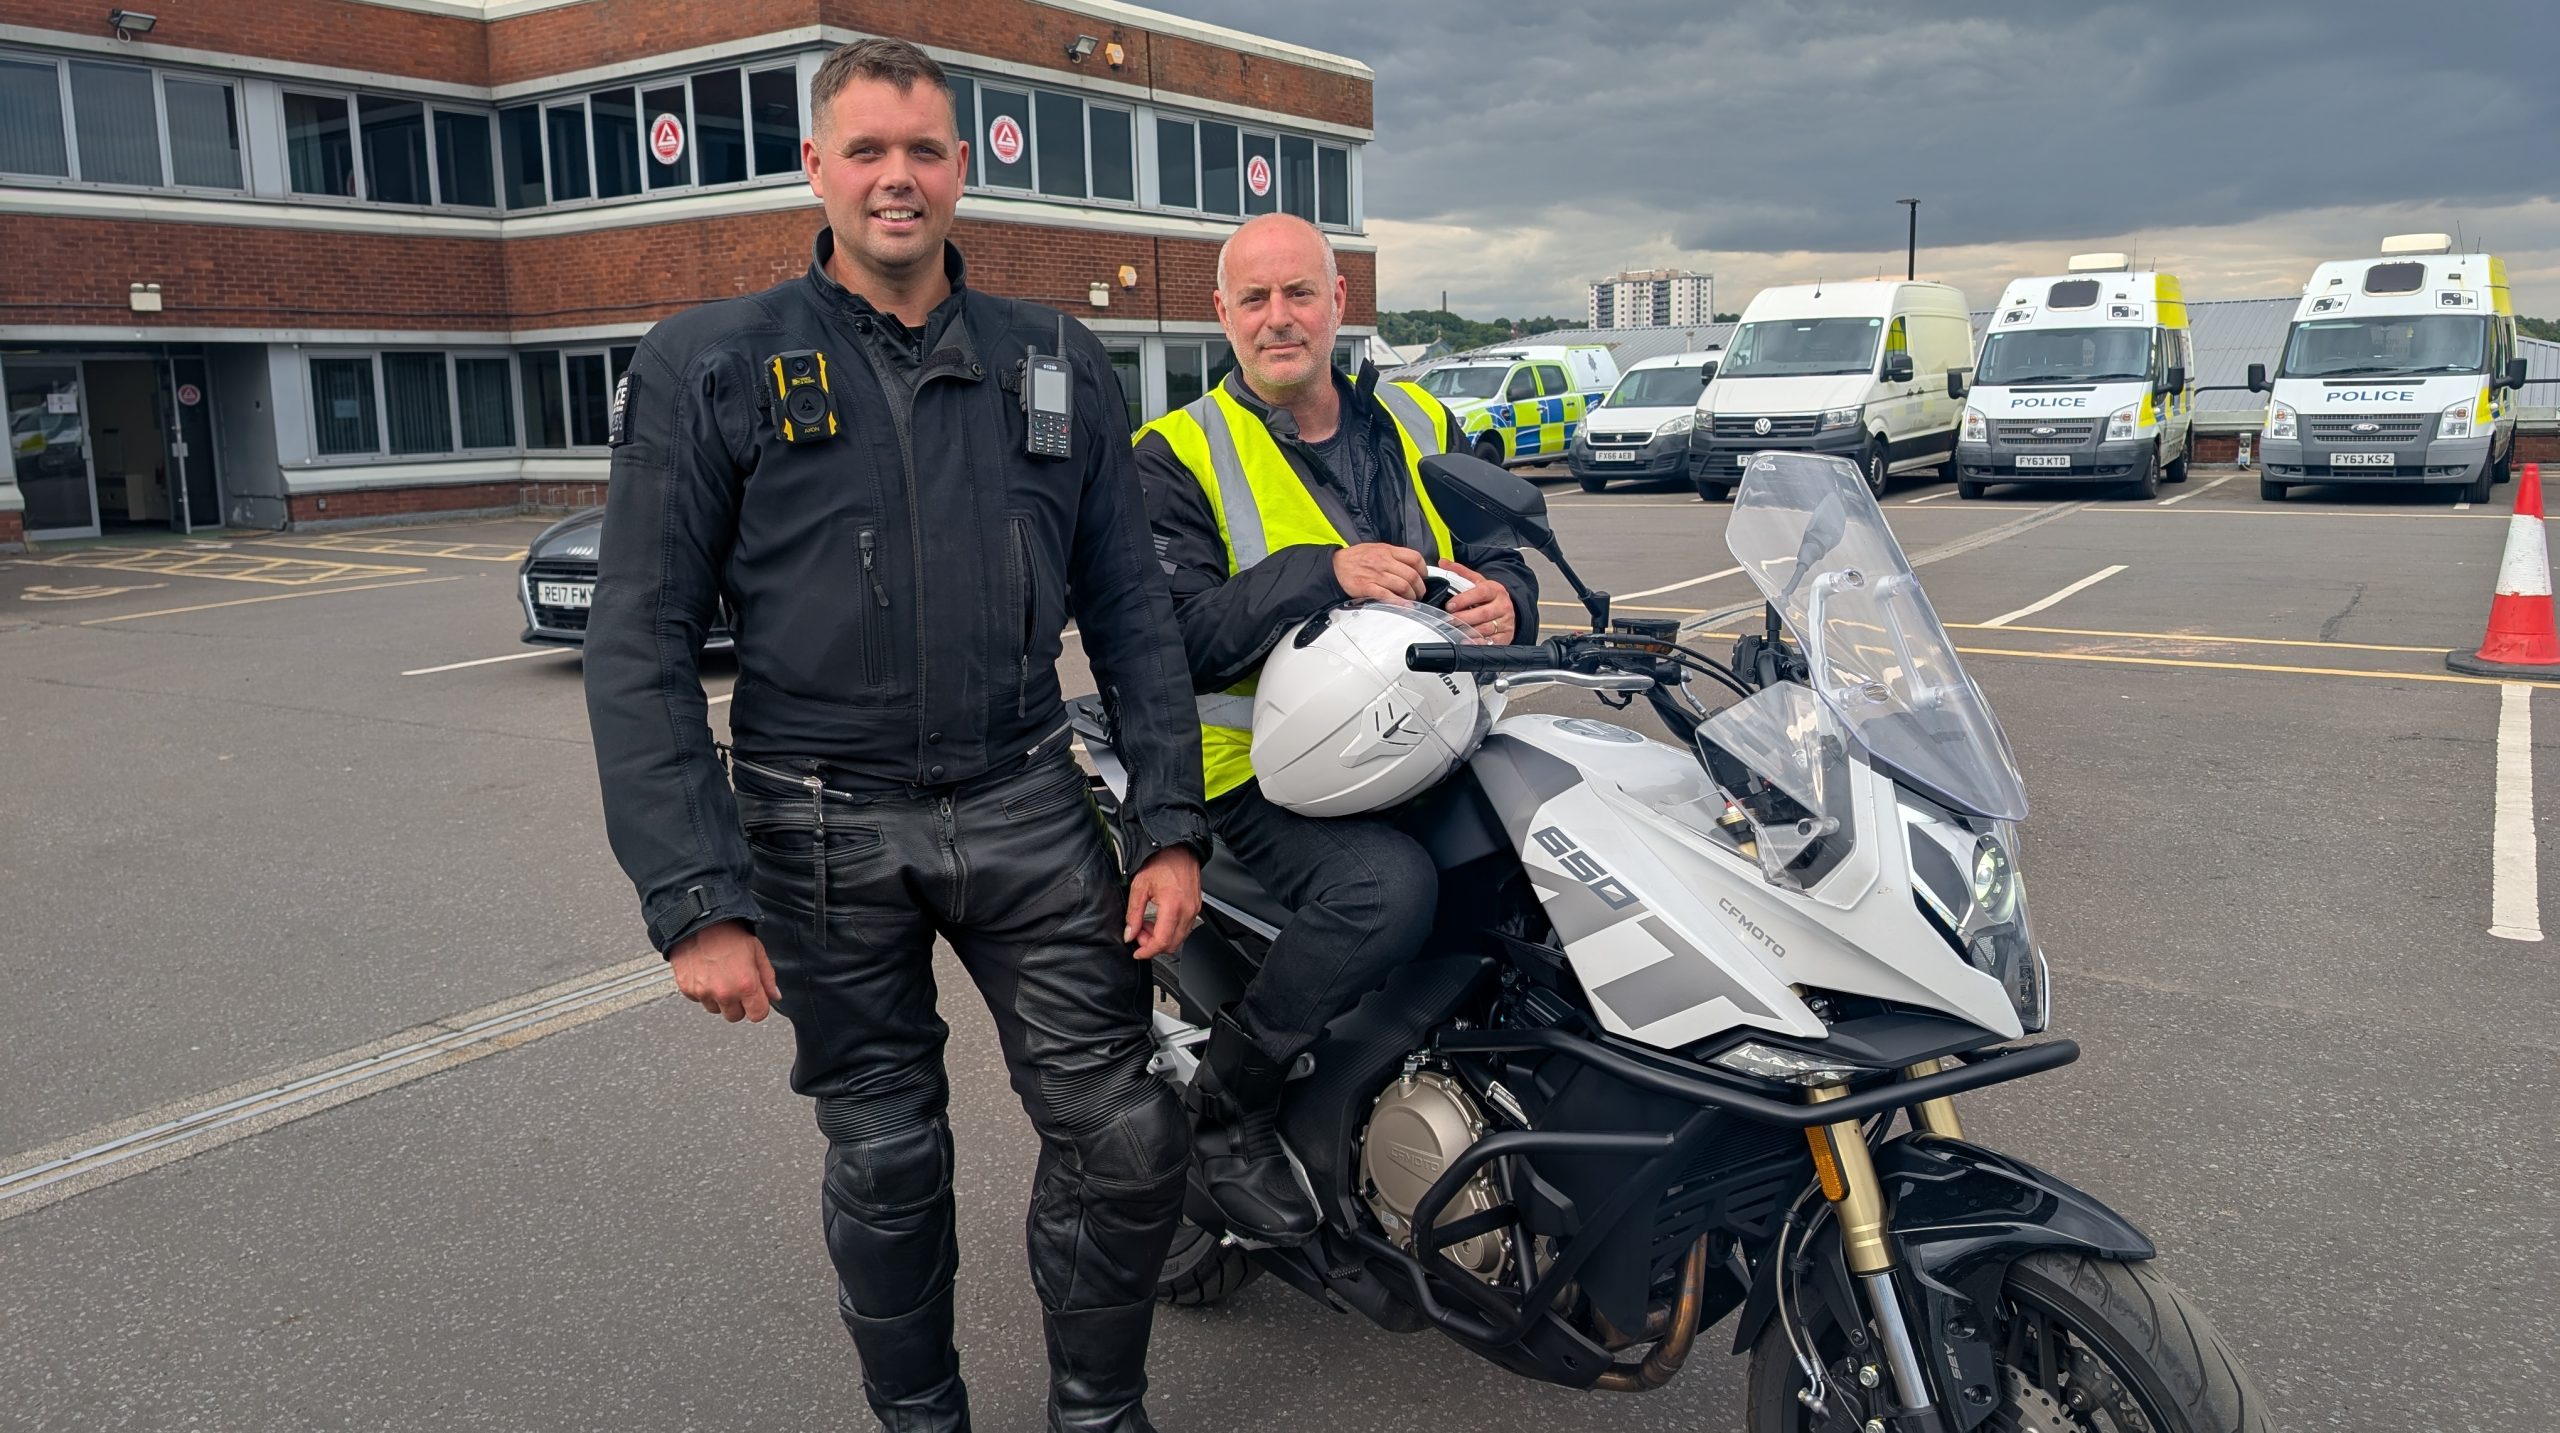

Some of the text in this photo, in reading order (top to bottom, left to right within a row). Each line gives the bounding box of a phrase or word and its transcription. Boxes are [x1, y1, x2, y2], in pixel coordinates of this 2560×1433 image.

[2010, 397, 2087, 409] POLICE
[2325, 390, 2415, 403] POLICE
[804, 426, 820, 434] AXON
[2019, 457, 2067, 466] FY63 KTD
[2335, 455, 2390, 464] FY63 KSZ
[544, 586, 568, 603] RE17
[1531, 825, 1641, 912] 650
[1718, 897, 1787, 959] CFMOTO
[1391, 1147, 1440, 1172] CFMOTO
[1943, 1342, 1963, 1380] ABS
